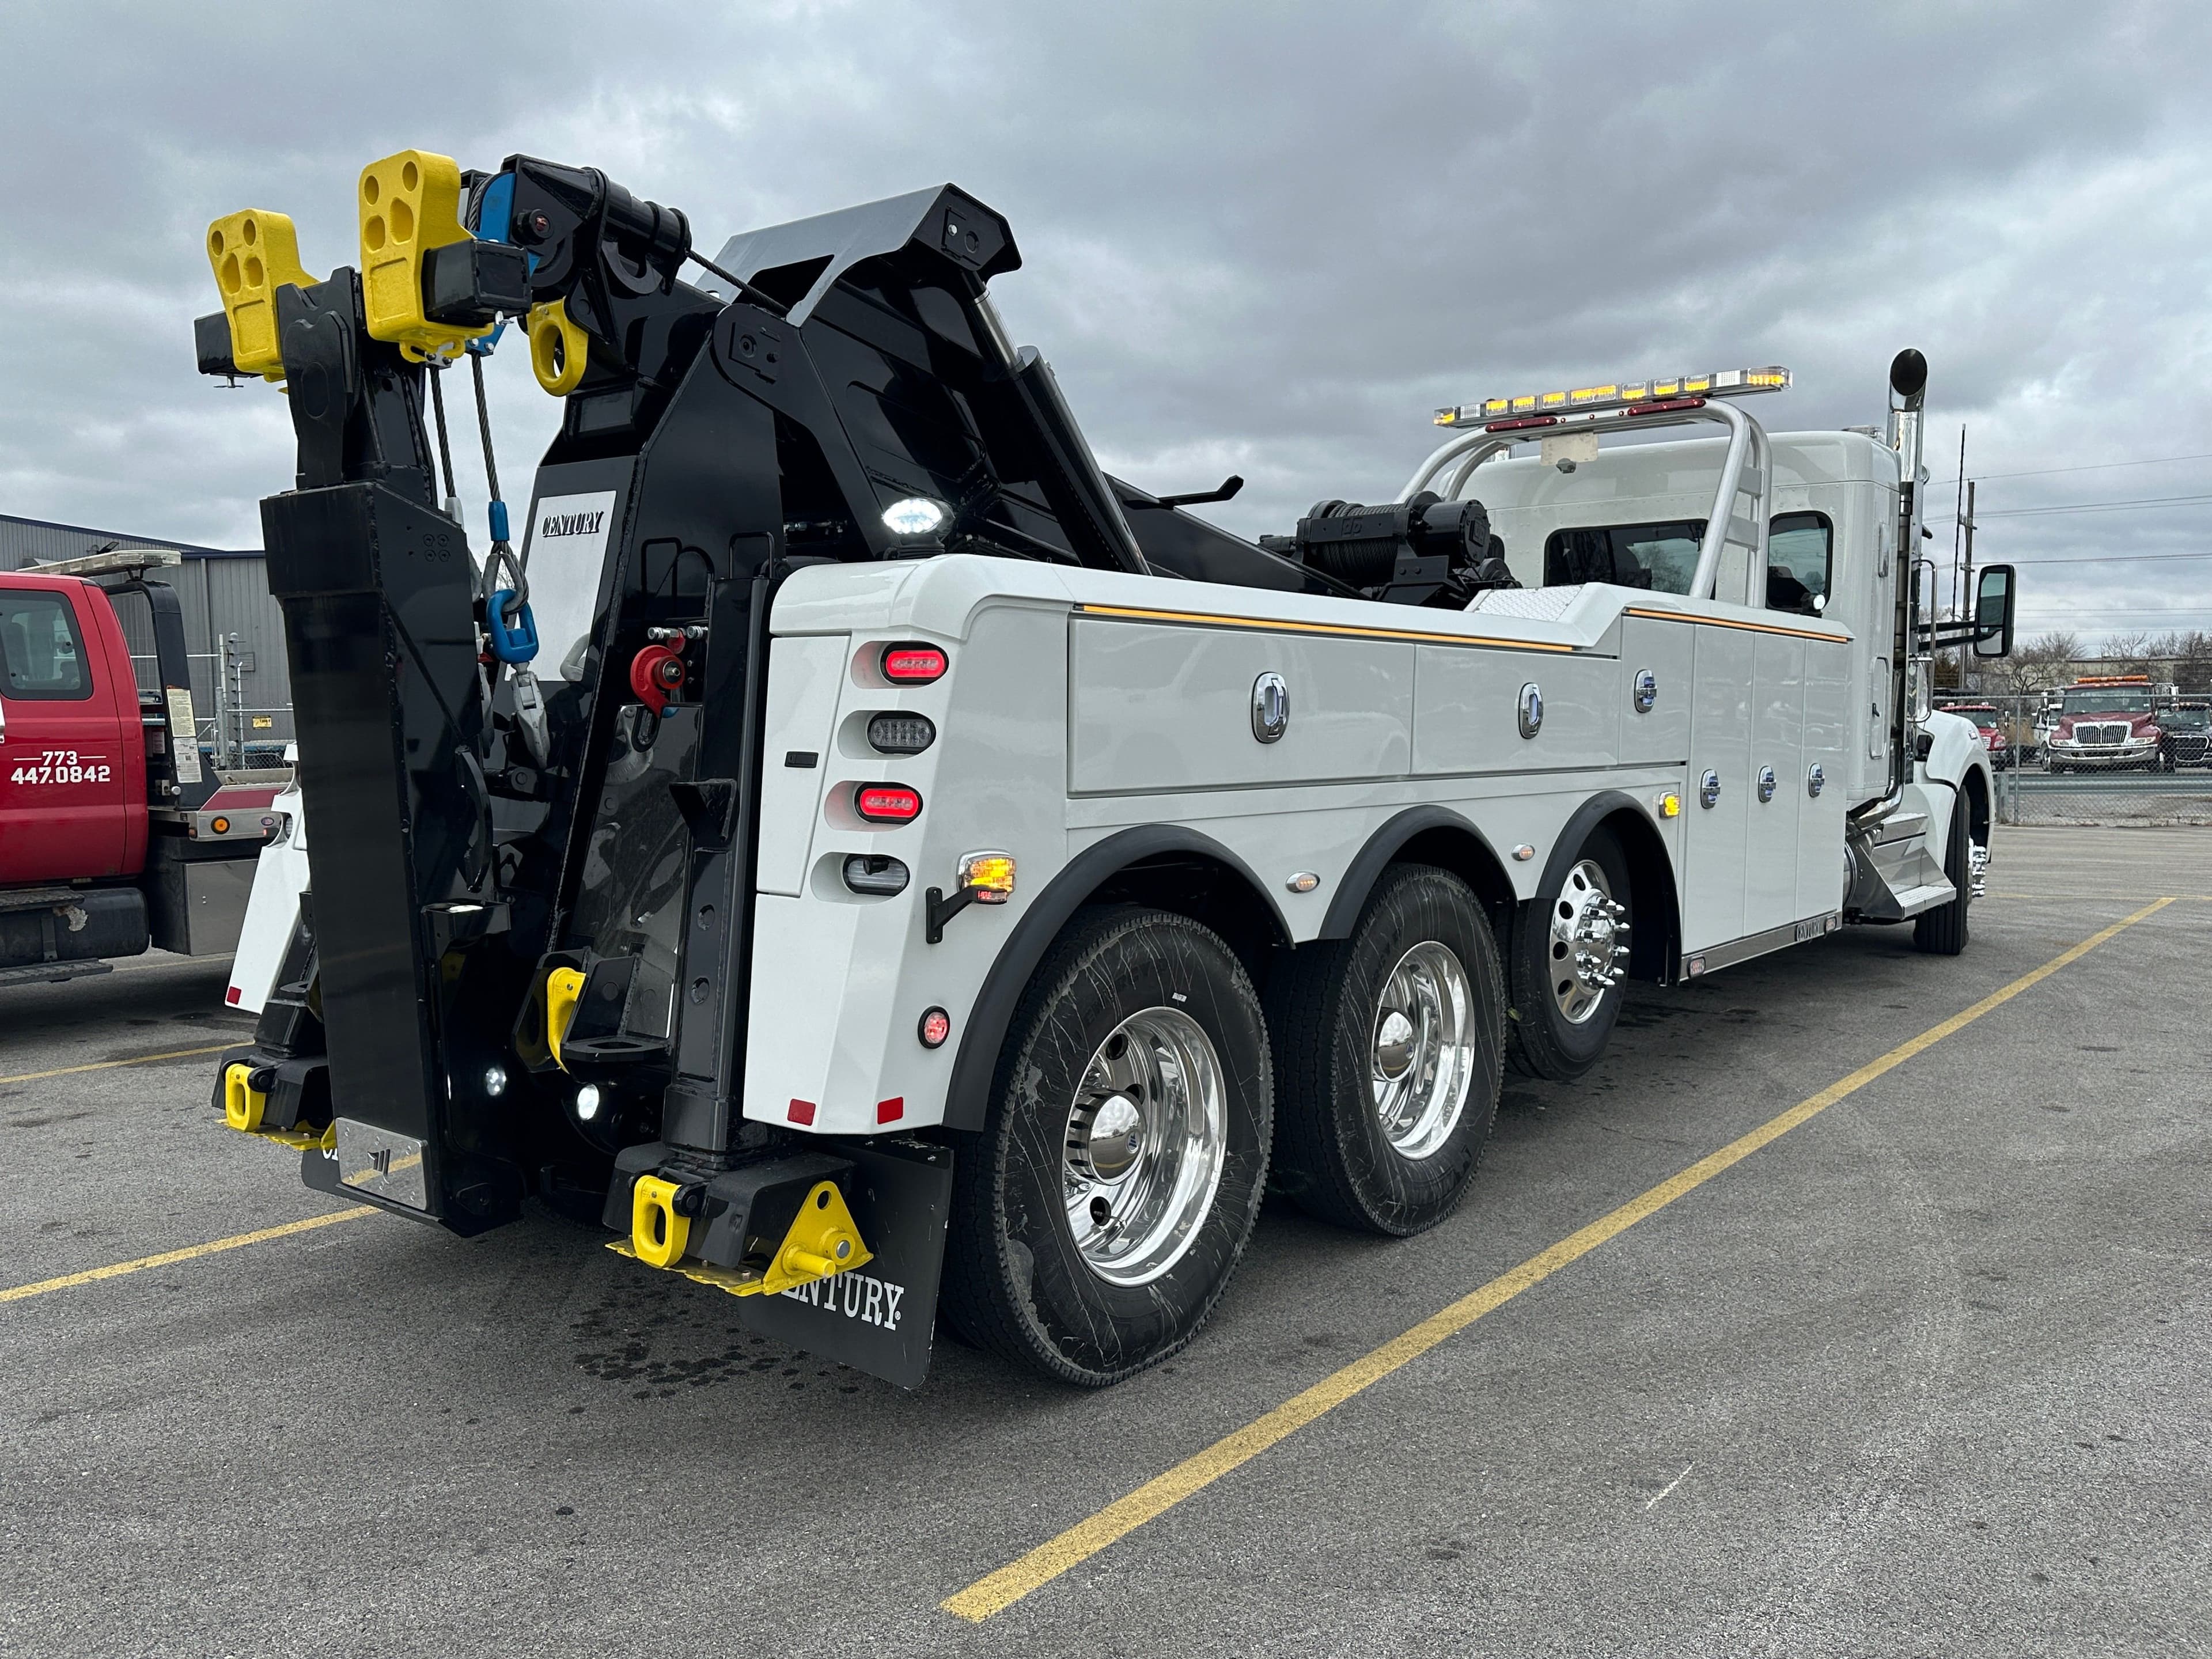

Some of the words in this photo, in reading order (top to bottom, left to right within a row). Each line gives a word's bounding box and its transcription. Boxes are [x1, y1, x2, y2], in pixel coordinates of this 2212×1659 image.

[541, 511, 604, 537] CENTURY
[42, 751, 77, 766] 773
[10, 766, 110, 785] 447.0842
[1797, 918, 1820, 942] CENTURY
[781, 1271, 904, 1331] NTURY
